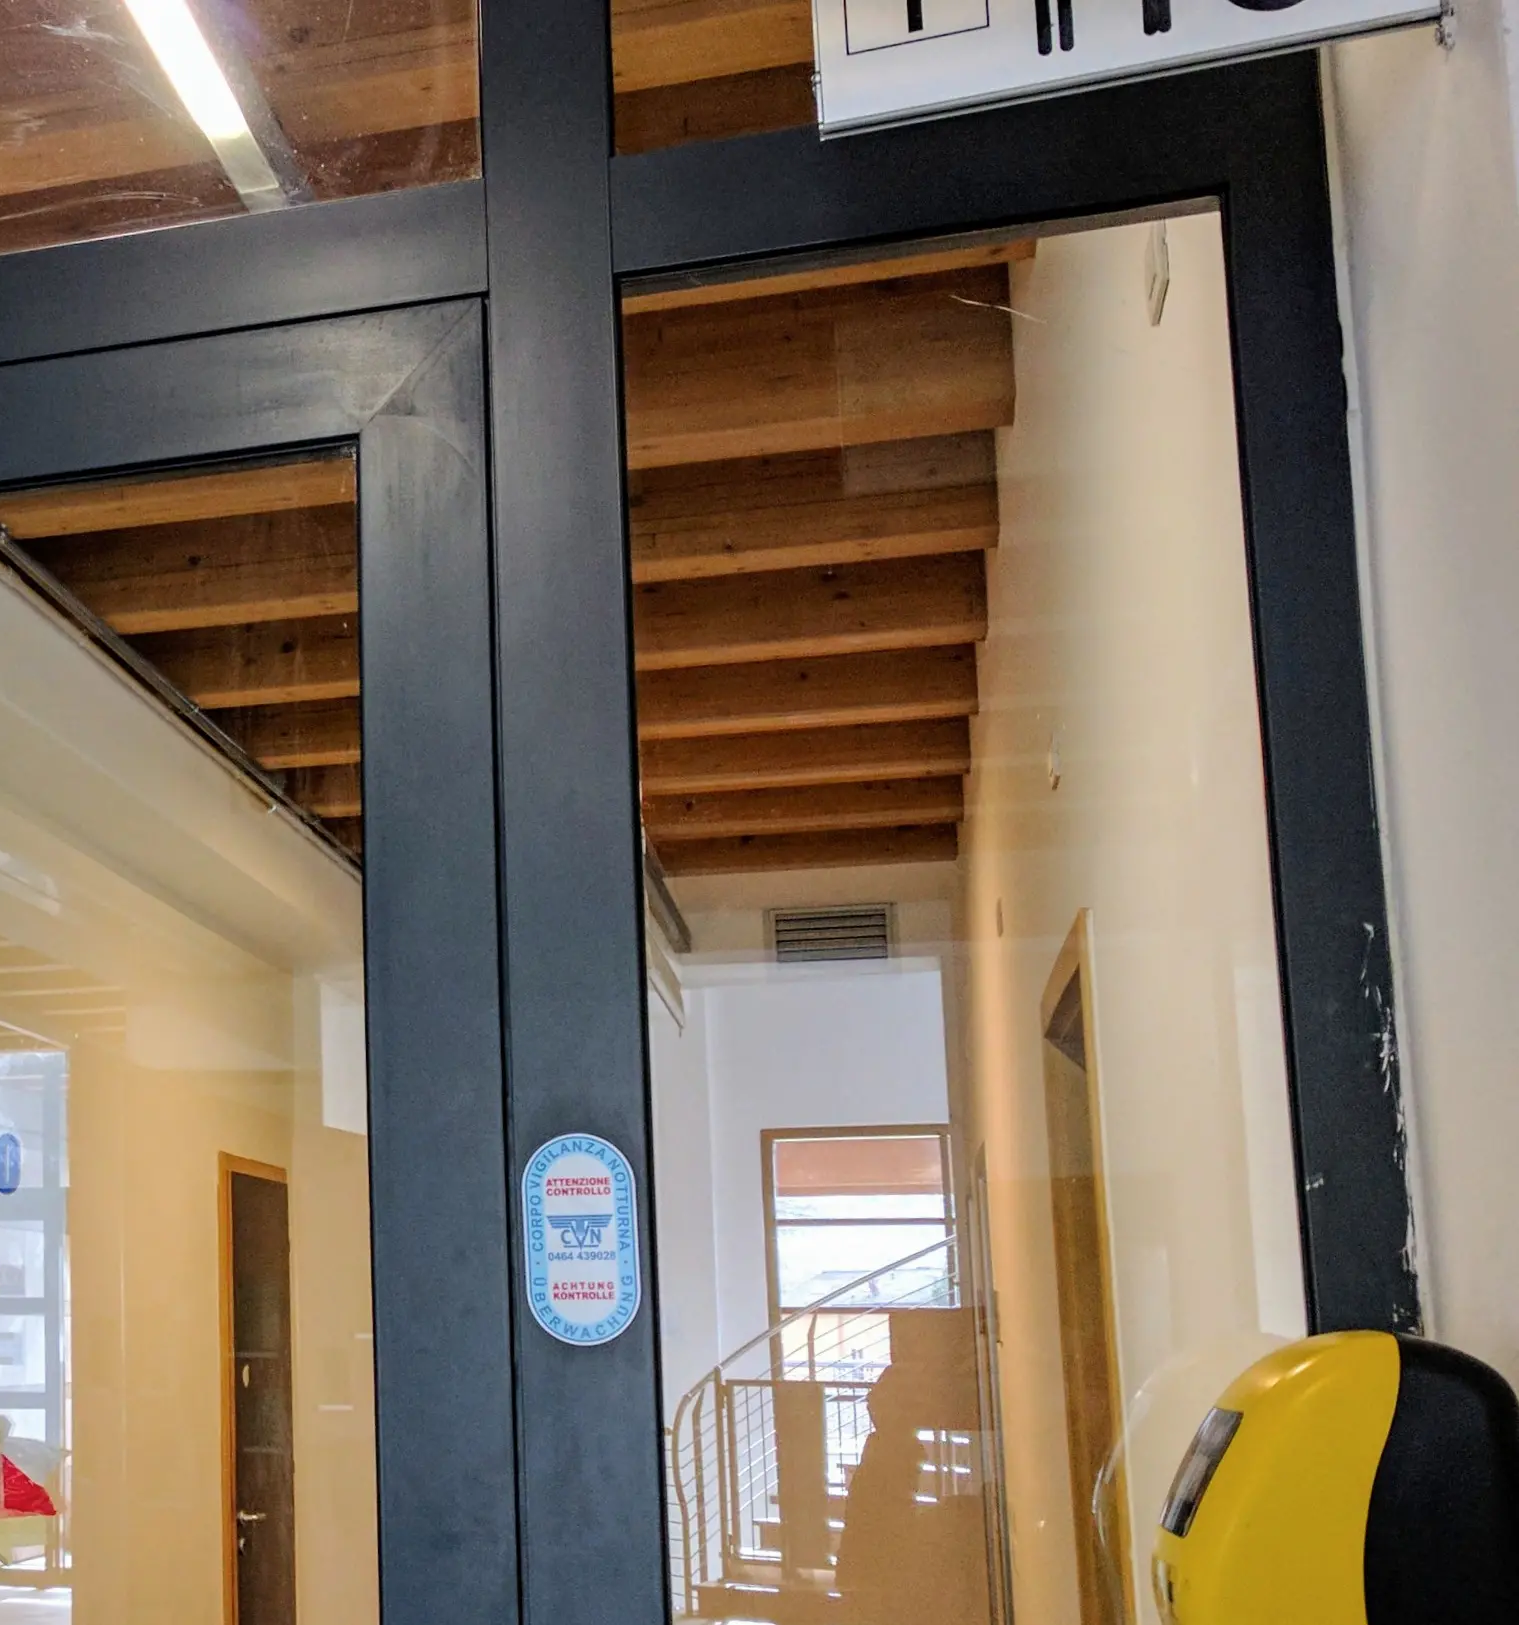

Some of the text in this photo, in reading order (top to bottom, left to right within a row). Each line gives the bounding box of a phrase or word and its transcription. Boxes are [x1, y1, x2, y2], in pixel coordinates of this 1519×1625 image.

[546, 1177, 611, 1187] ATTENZIONE
[530, 1139, 631, 1252] CORPO VIGILANZA NOTTURNA
[546, 1187, 612, 1197] CONTROLLO
[547, 1251, 574, 1261] 0464
[552, 1282, 615, 1291] ACHTUNG
[553, 1291, 616, 1300] KONTROLLE
